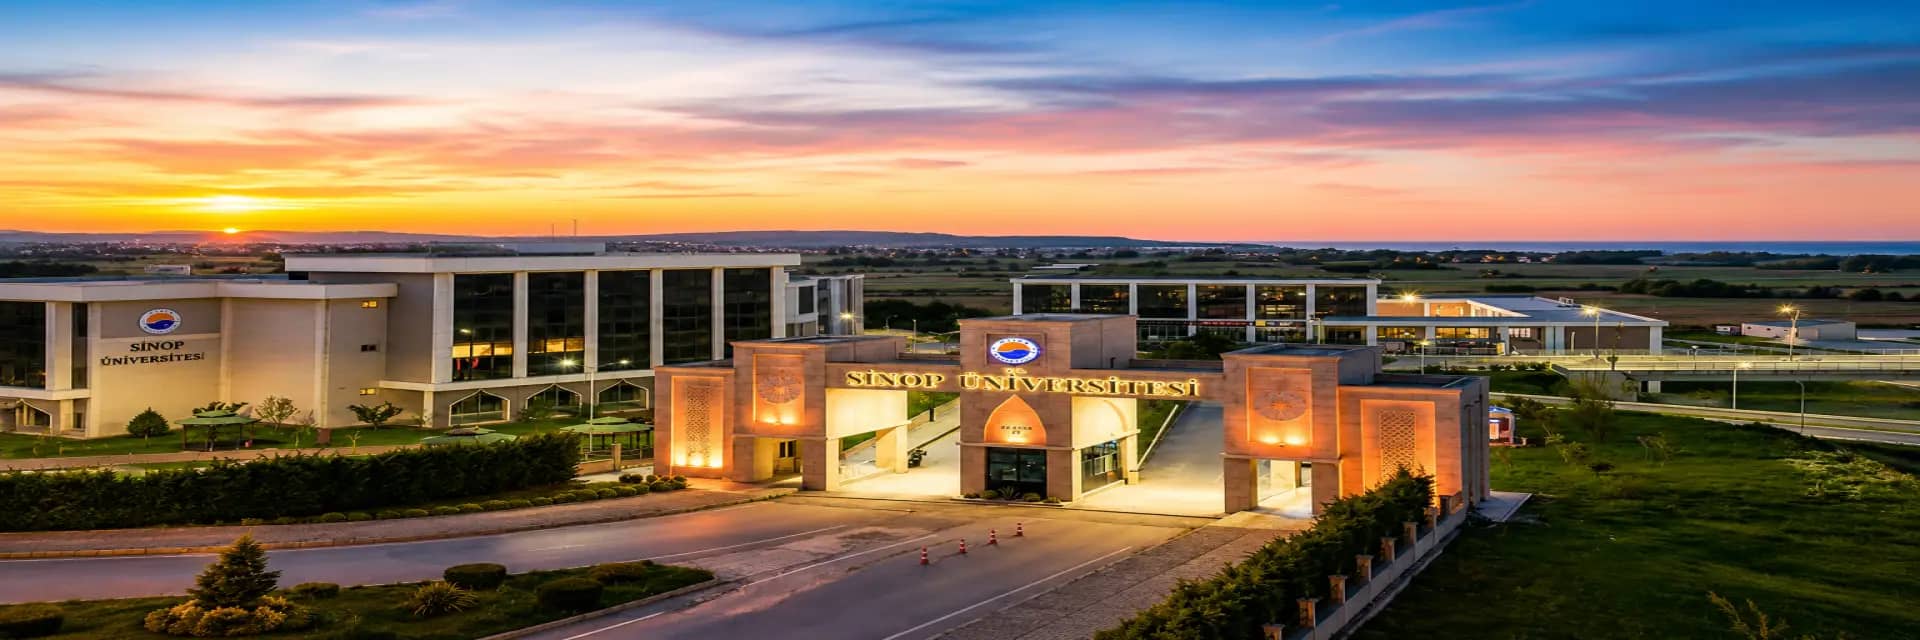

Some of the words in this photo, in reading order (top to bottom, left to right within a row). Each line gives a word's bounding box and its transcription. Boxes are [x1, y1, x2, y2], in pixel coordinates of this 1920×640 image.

[130, 340, 184, 352] SİNOP
[101, 352, 205, 366] ÜNİVERSİTESİ
[847, 369, 944, 388] SİNOP
[959, 371, 1200, 397] ÜNİVERSİTESİ
